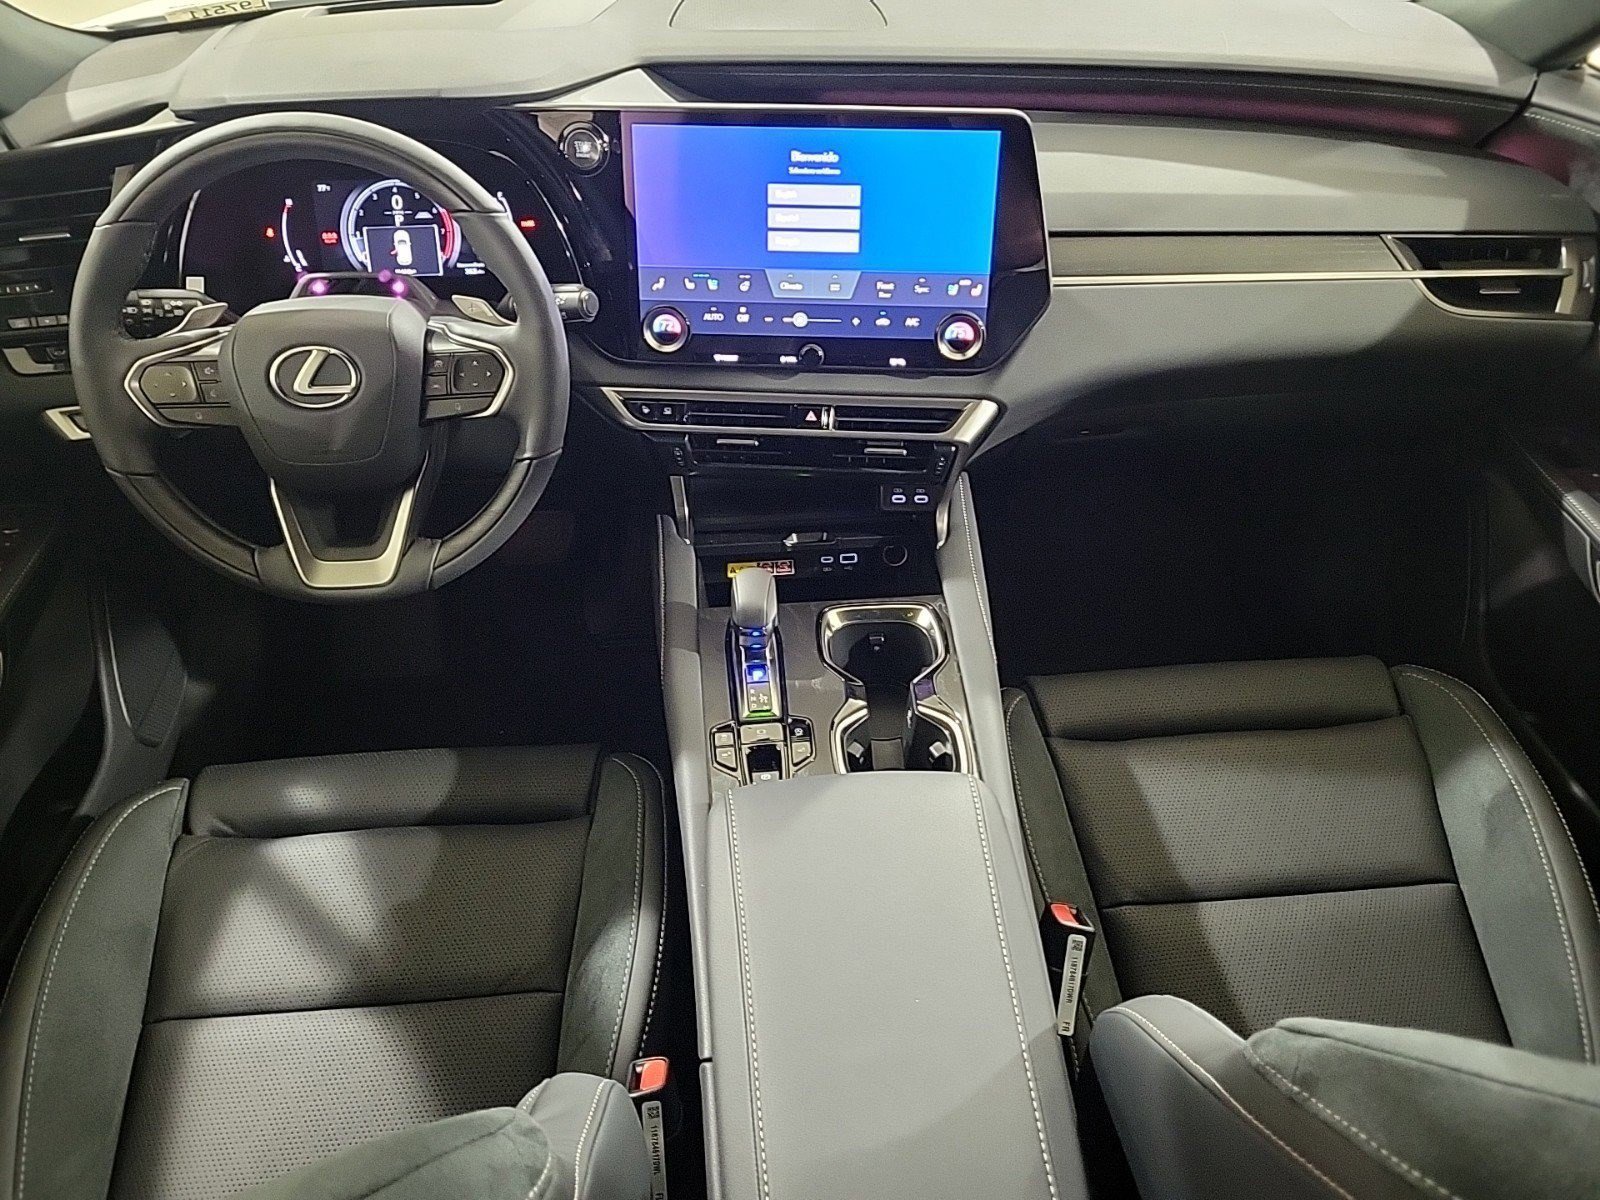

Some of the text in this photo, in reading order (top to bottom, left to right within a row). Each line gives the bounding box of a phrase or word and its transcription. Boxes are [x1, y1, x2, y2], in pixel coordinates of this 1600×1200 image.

[391, 195, 403, 210] 0
[703, 313, 725, 321] AUTO
[753, 670, 763, 681] P
